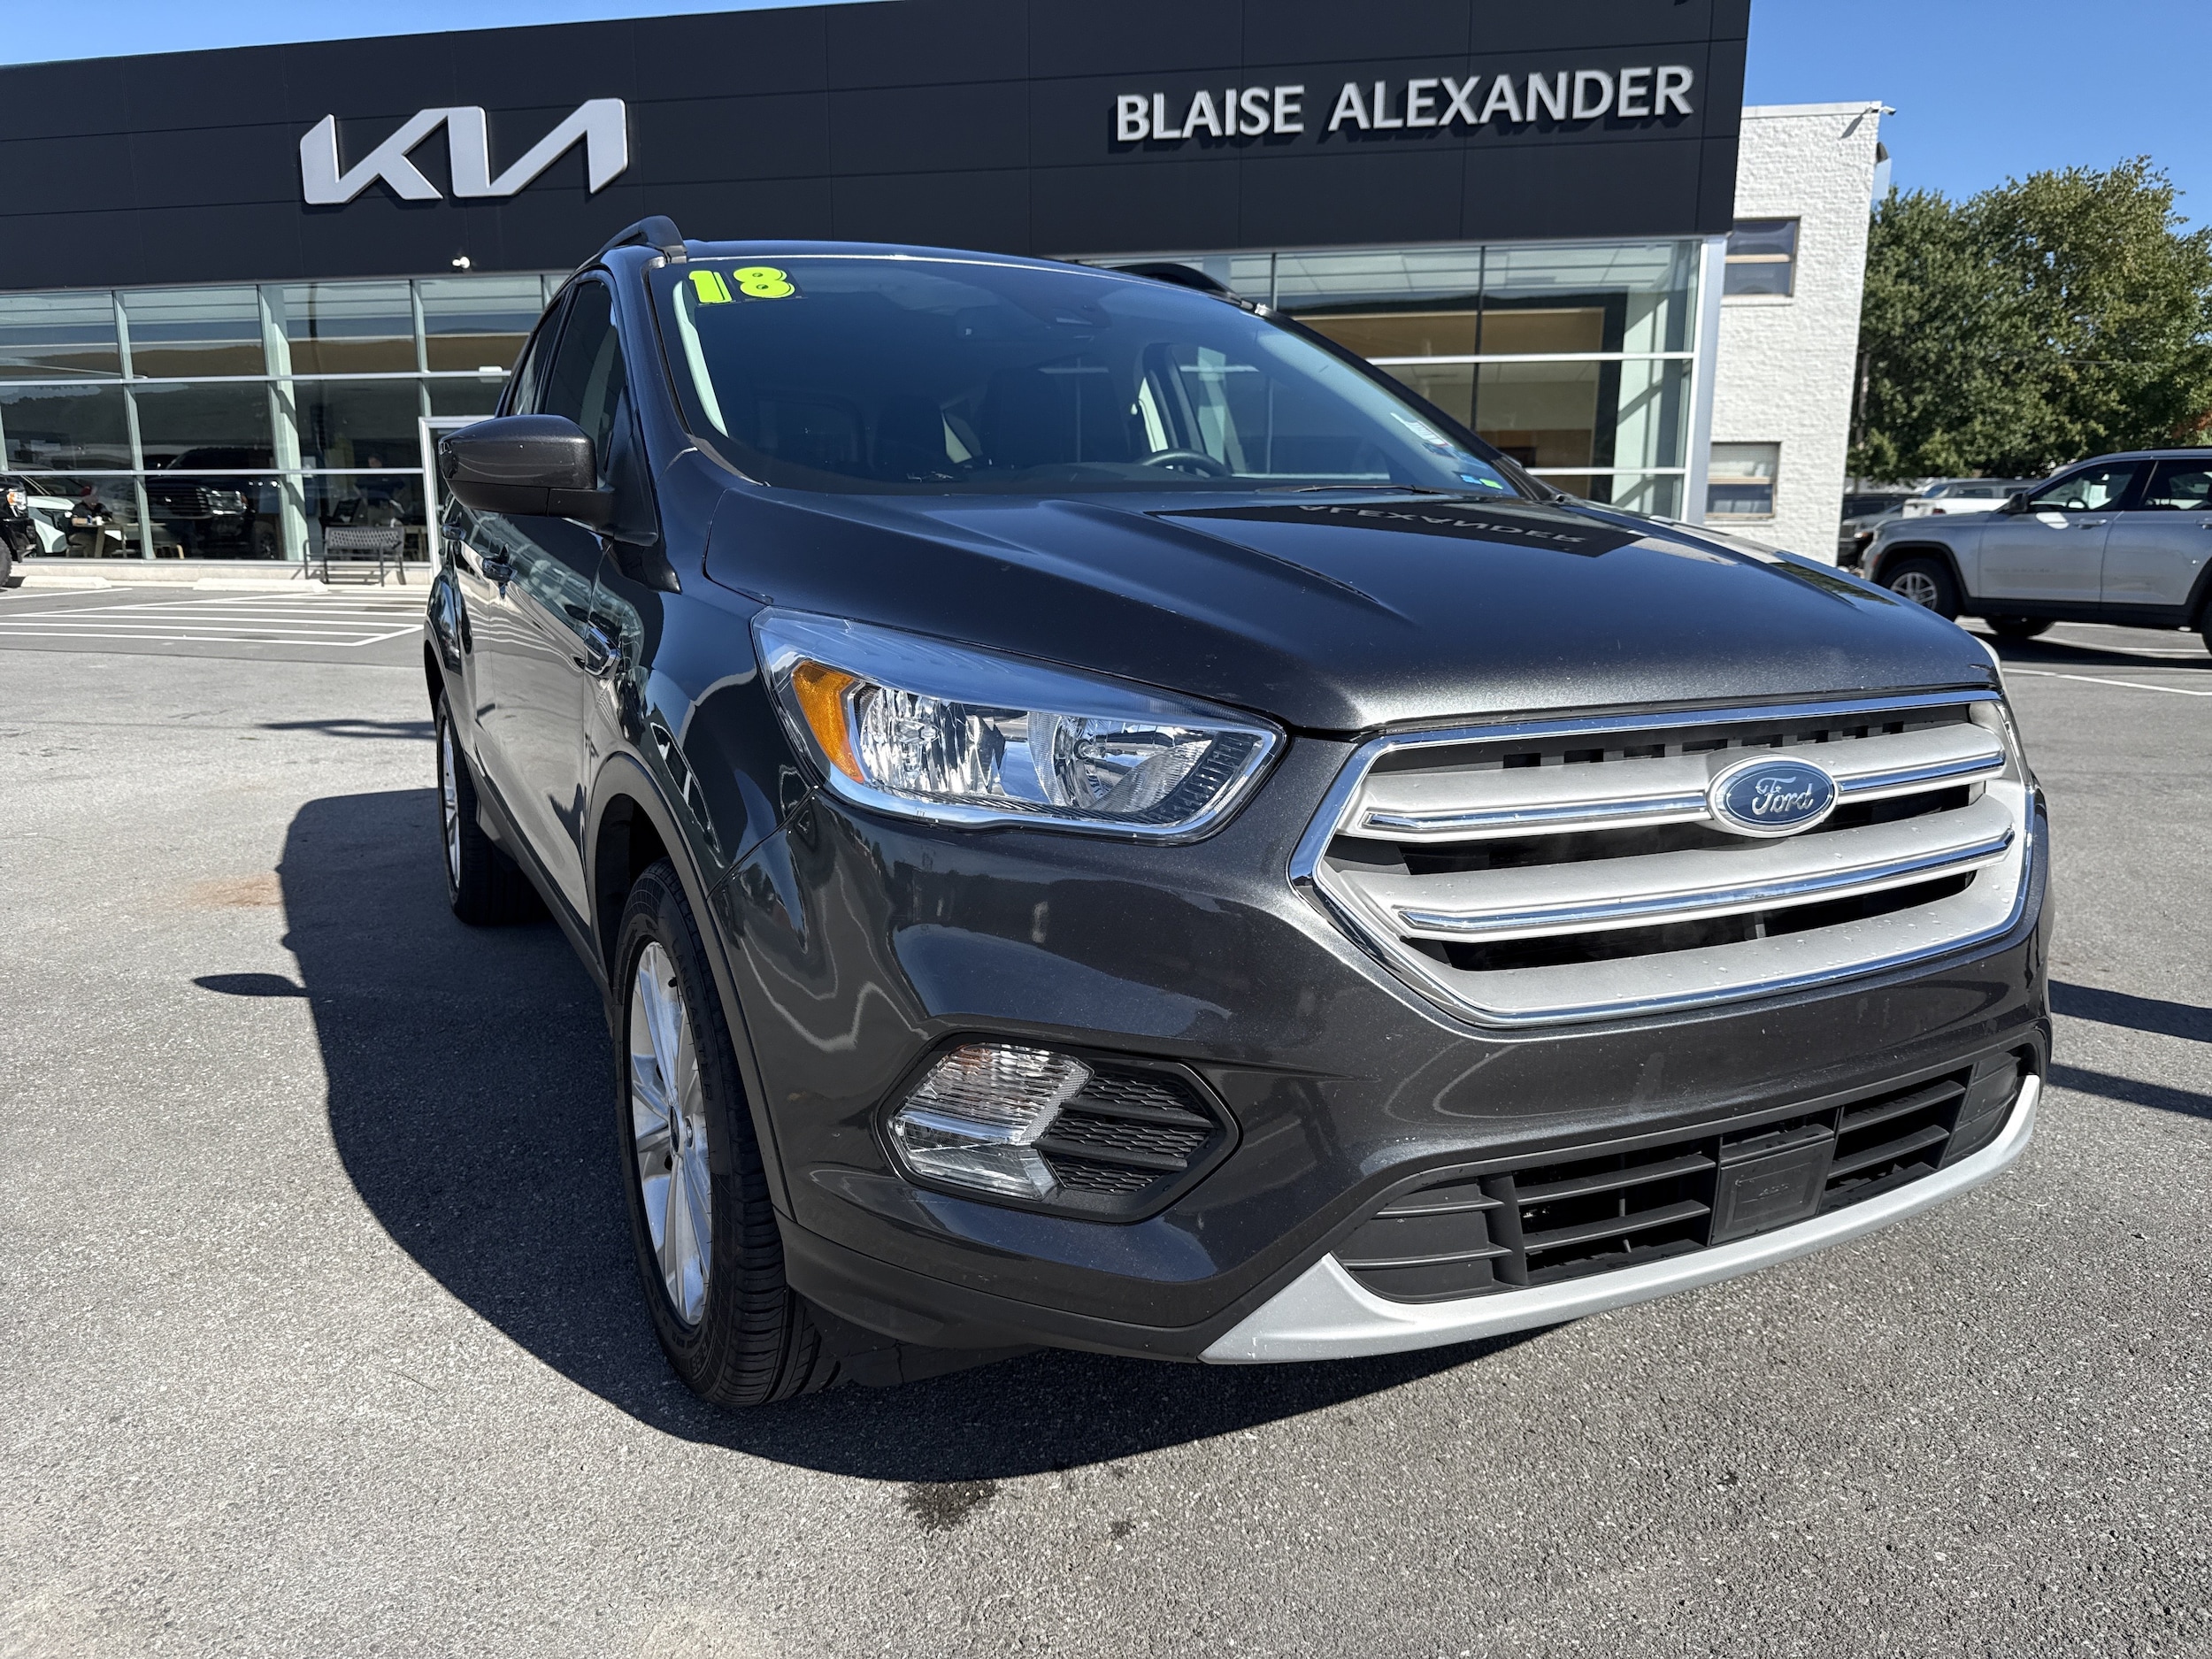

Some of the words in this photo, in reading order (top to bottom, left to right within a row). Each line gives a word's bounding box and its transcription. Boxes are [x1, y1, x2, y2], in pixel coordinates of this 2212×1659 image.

[1116, 85, 1305, 142] BLAISE
[1329, 65, 1694, 132] ALEXANDER
[300, 97, 628, 204] KIA
[688, 266, 795, 303] 18
[1752, 776, 1814, 816] Ford
[672, 938, 713, 1102] LANCASTER
